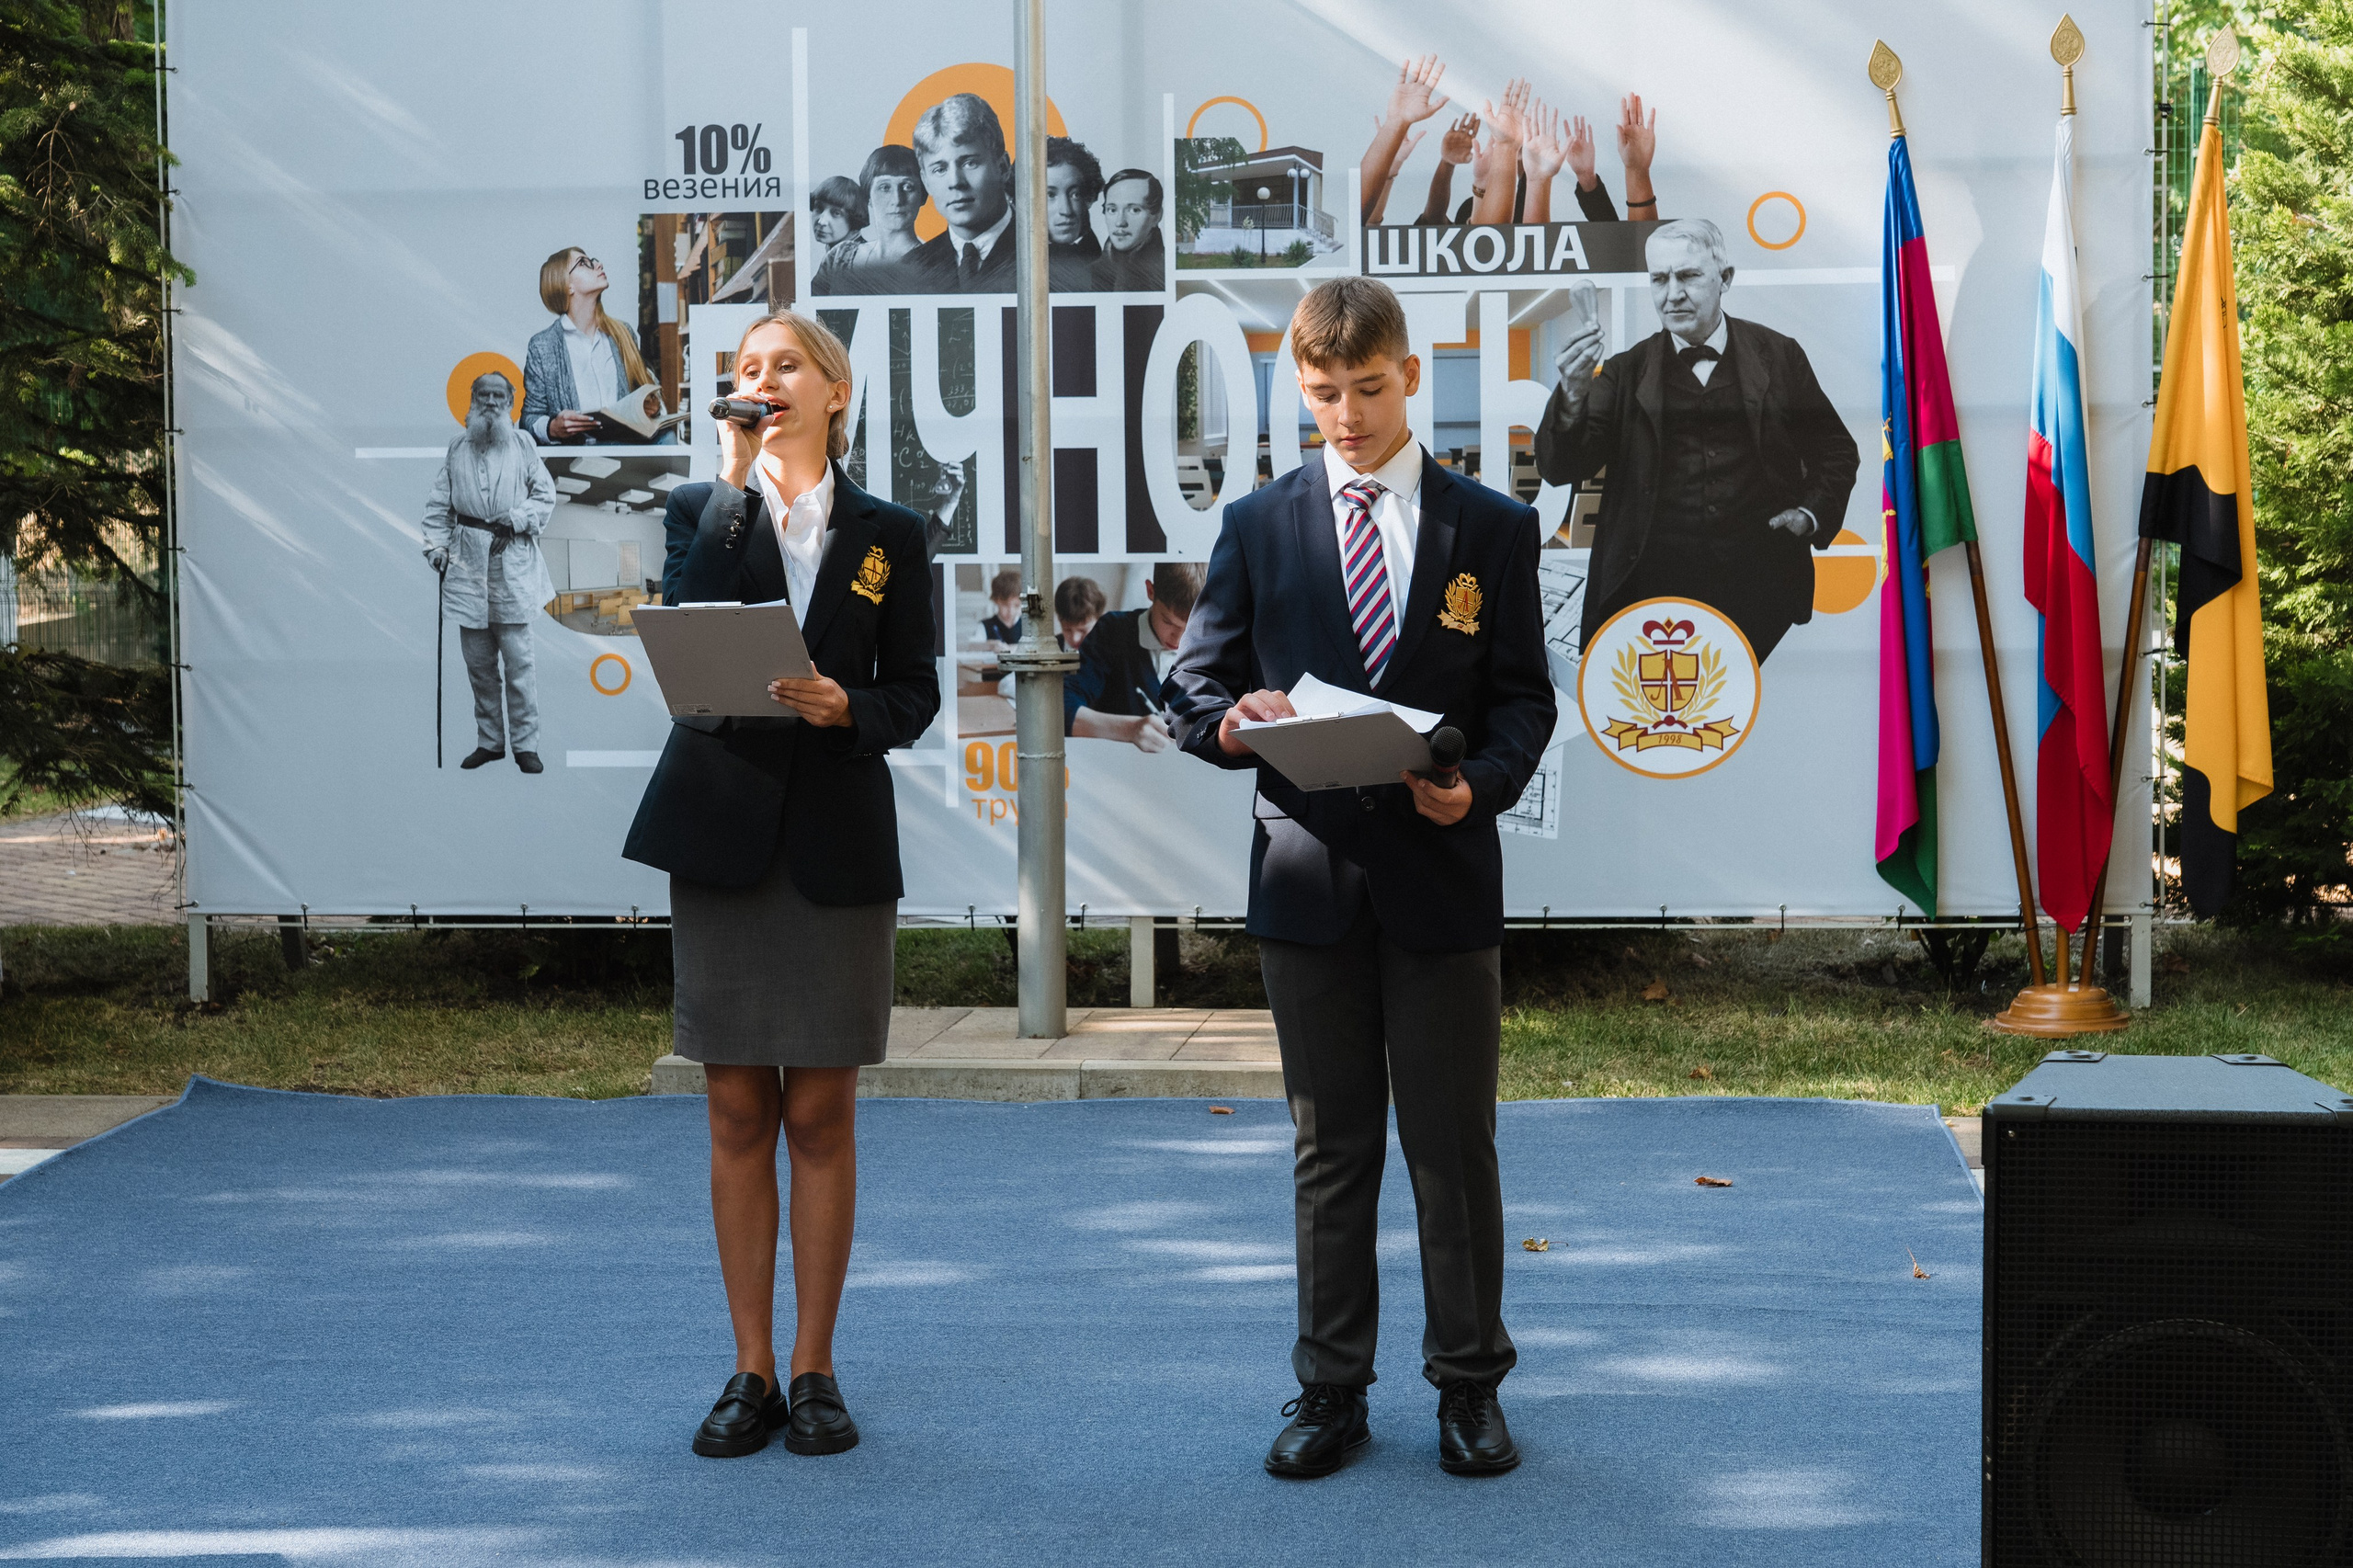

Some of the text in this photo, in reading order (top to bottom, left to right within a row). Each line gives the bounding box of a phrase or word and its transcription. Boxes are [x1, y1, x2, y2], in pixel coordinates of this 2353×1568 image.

[675, 122, 771, 176] 10%
[643, 176, 780, 200] везения
[1368, 225, 1590, 274] ШКОЛА
[1657, 734, 1683, 744] 1998
